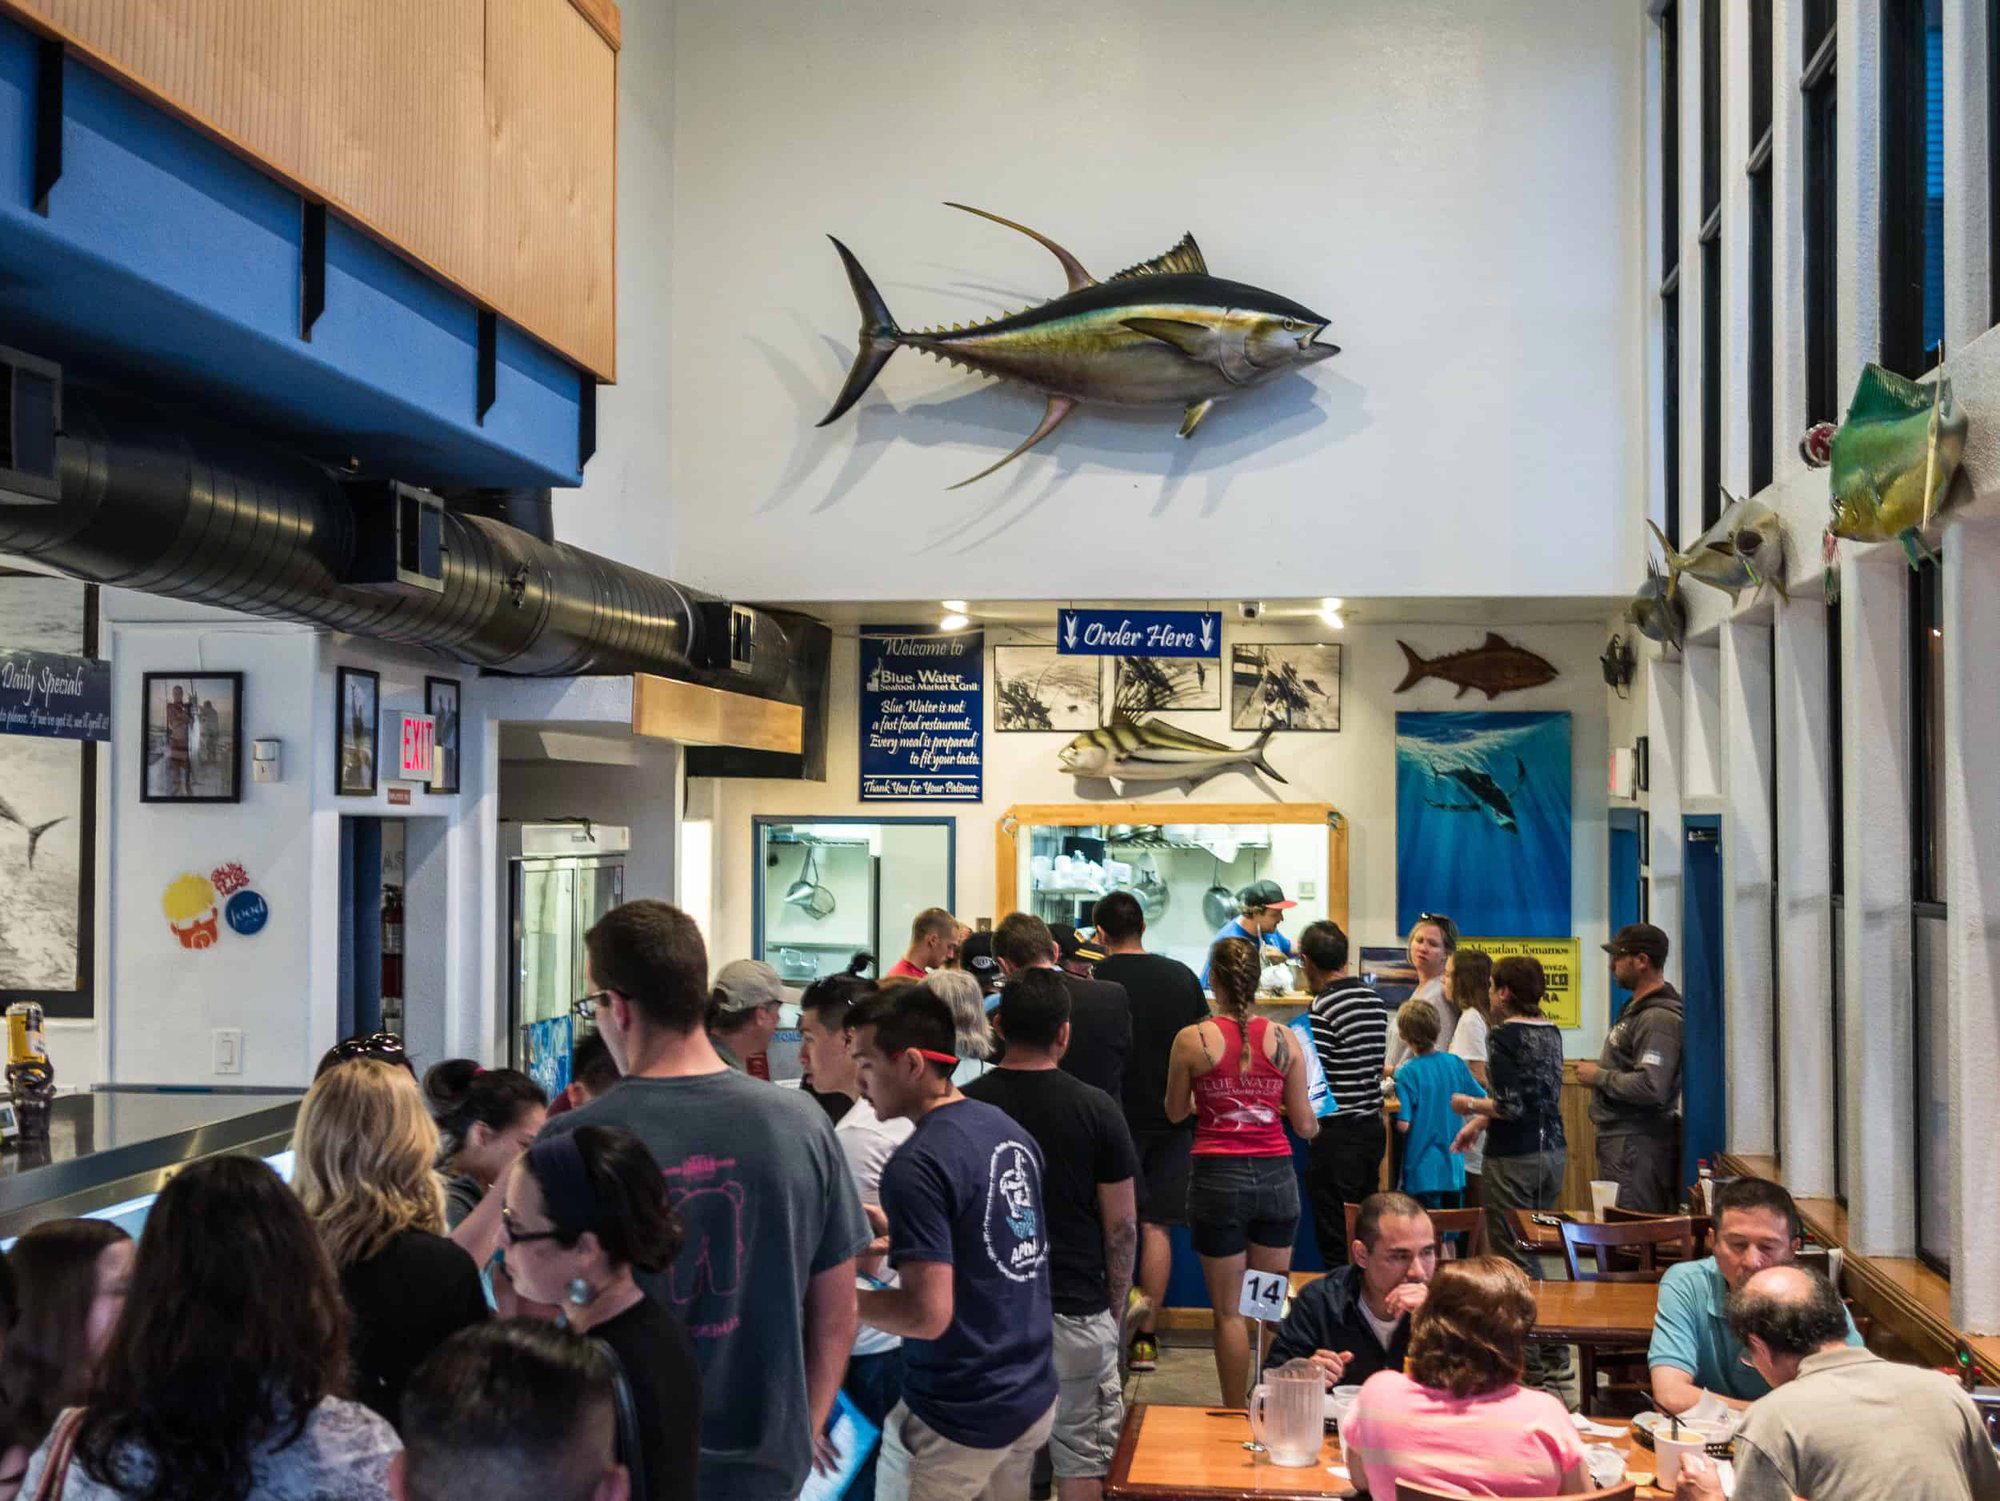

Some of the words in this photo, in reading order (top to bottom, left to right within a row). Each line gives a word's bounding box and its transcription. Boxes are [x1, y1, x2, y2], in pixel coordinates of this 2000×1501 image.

[1084, 619, 1142, 646] Order
[1146, 624, 1196, 648] Here
[883, 637, 947, 656] Welcome
[950, 637, 963, 656] to
[1, 659, 35, 706] Daily
[38, 666, 83, 708] Specials
[881, 670, 913, 684] Blue
[917, 669, 964, 683] Water
[880, 683, 915, 691] Seafood
[917, 683, 949, 691] Market
[950, 683, 958, 691] &
[880, 698, 904, 713] Blue
[905, 699, 938, 713] Water
[939, 700, 946, 713] is
[948, 700, 966, 713] not
[871, 722, 878, 730] a
[880, 714, 898, 734] fast
[898, 714, 923, 734] food
[402, 718, 433, 771] EXIT
[869, 733, 899, 754] Every
[900, 731, 925, 748] meal
[925, 735, 931, 748] is
[932, 731, 979, 754] prepared
[910, 751, 920, 765] to
[919, 749, 934, 769] fit
[929, 754, 955, 772] your
[863, 779, 890, 794] Thank
[891, 780, 909, 795] You
[909, 779, 922, 796] for
[922, 781, 945, 795] Your
[1522, 944, 1569, 955] Tomamos
[1247, 1276, 1281, 1305] 14
